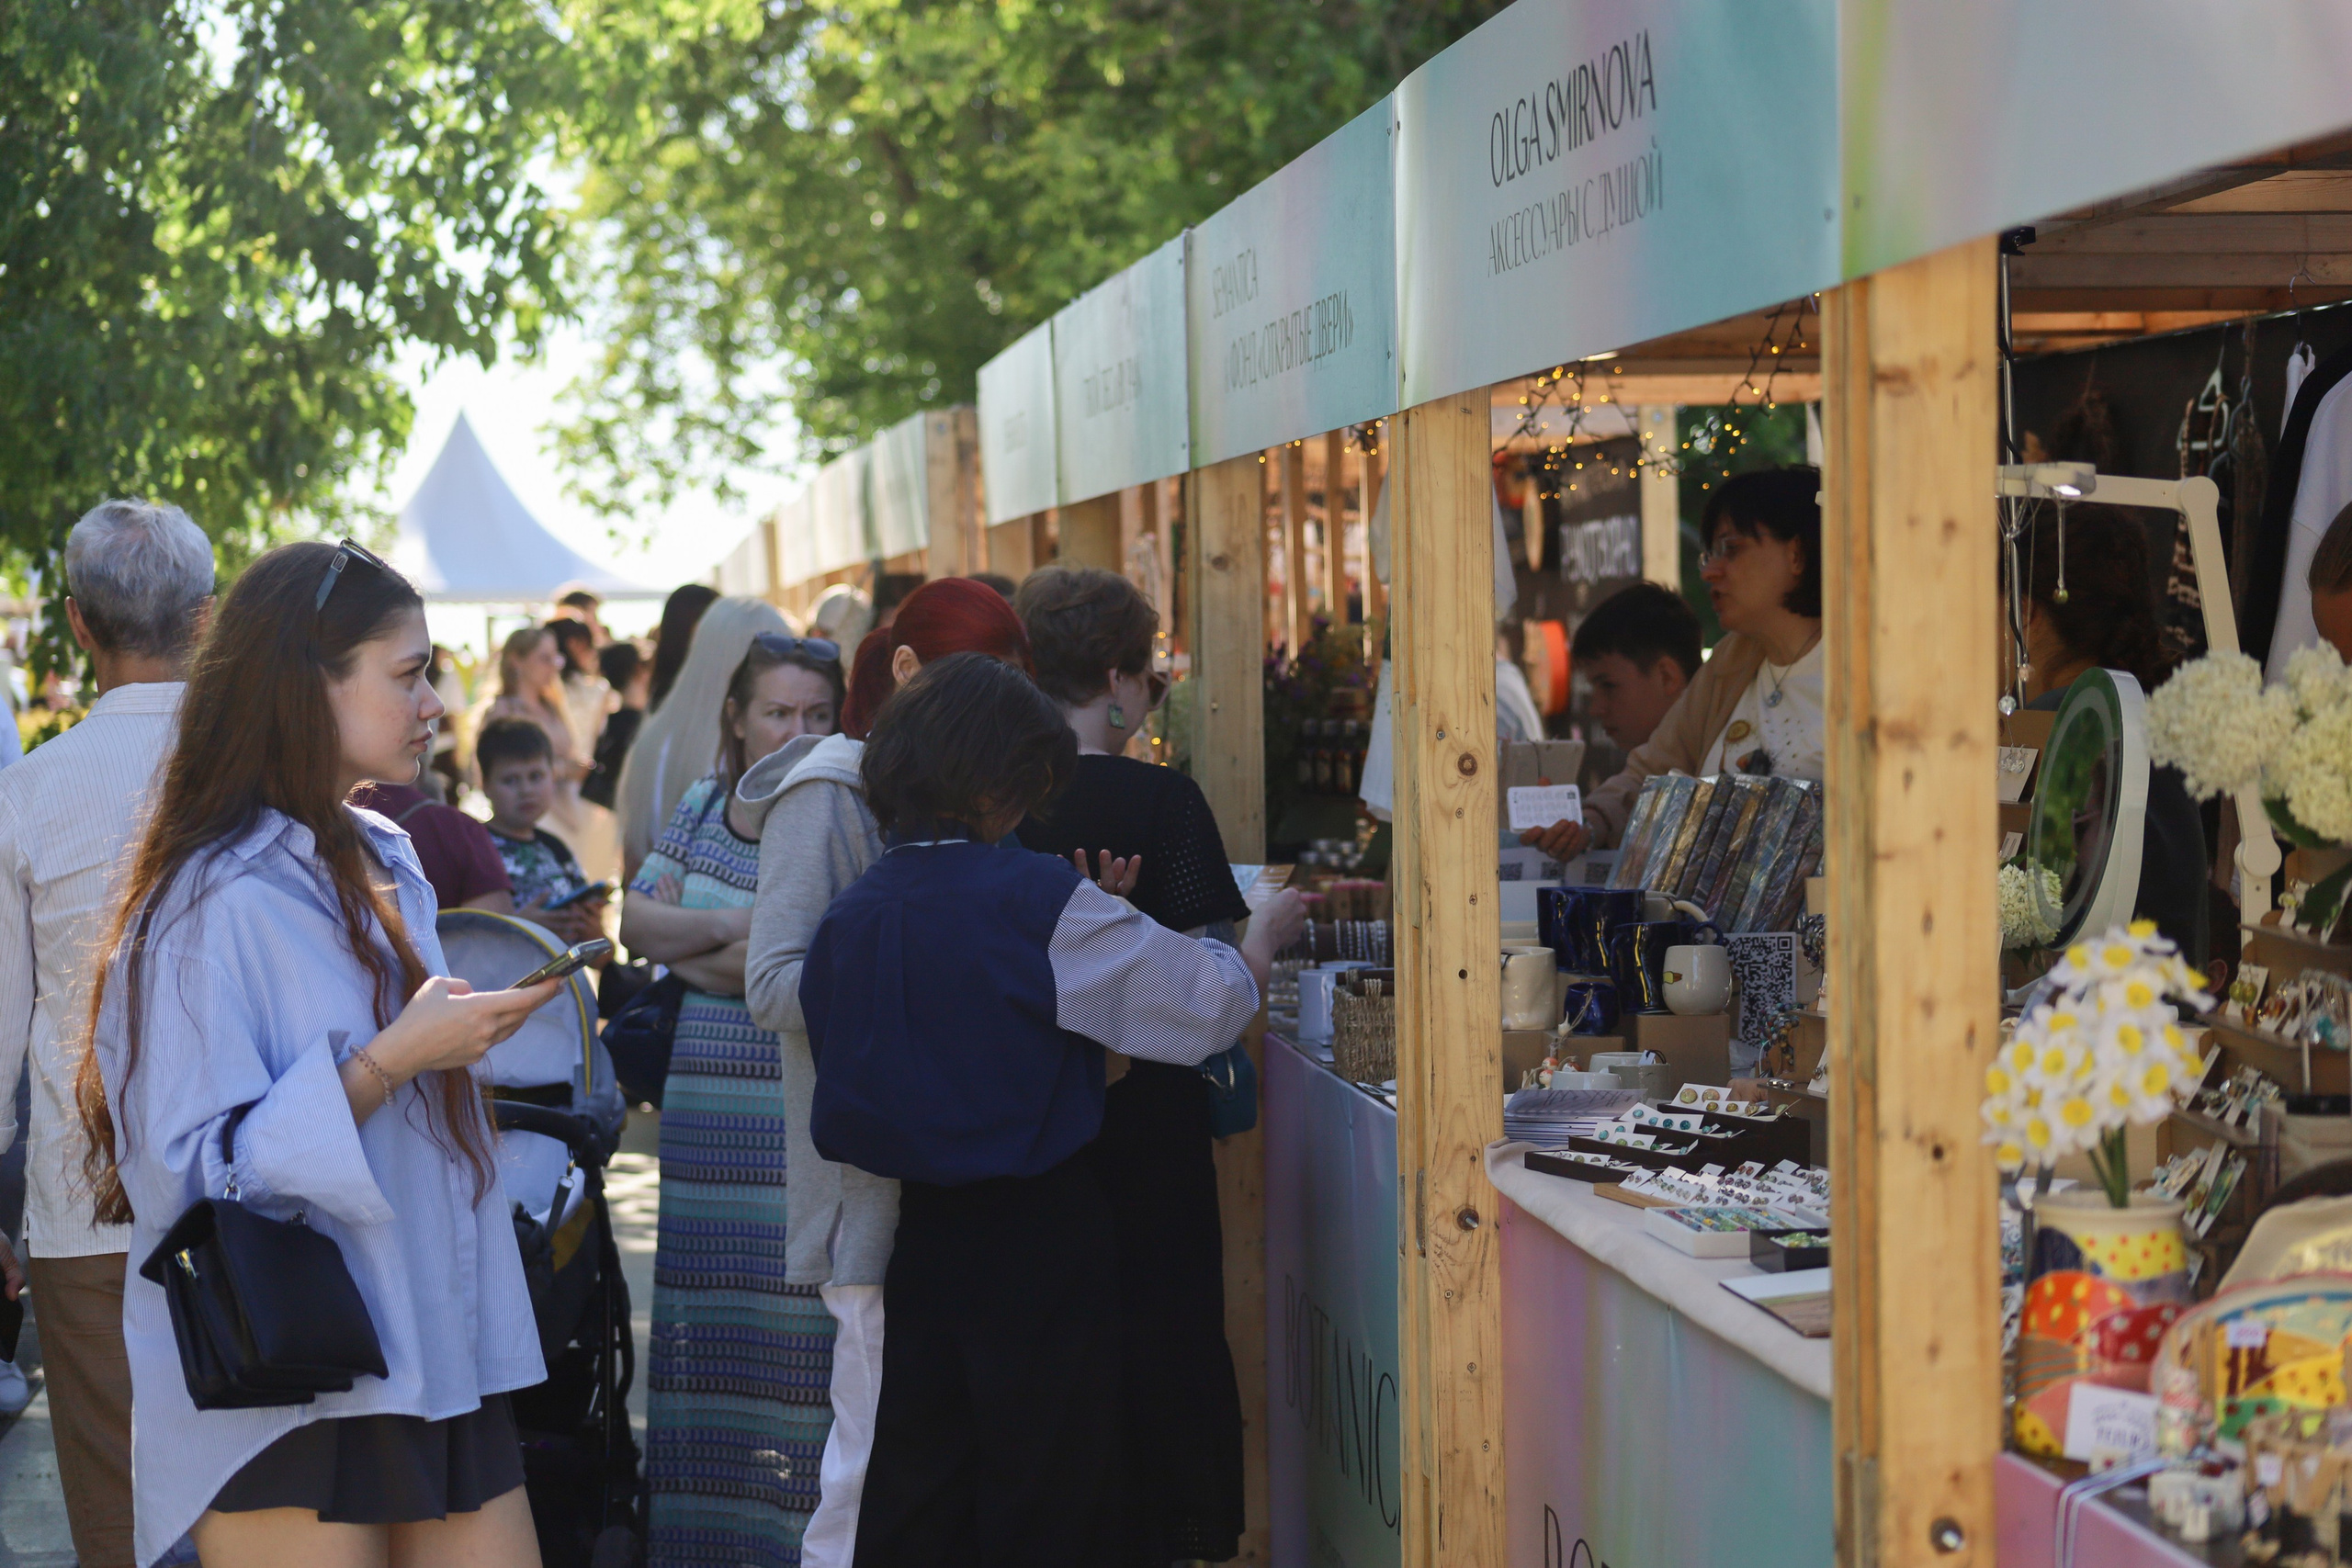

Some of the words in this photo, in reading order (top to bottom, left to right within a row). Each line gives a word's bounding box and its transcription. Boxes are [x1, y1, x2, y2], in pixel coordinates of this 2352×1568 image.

[1490, 91, 1543, 188] OLGA
[1545, 28, 1657, 162] SMIRNOVA
[1487, 186, 1579, 278] АКСЕССУАРЫ
[1583, 179, 1595, 239] С
[1597, 135, 1663, 247] ДУШОЙ
[1313, 288, 1353, 373] ДВЕРИ»
[1285, 1274, 1401, 1536] BOTANIC
